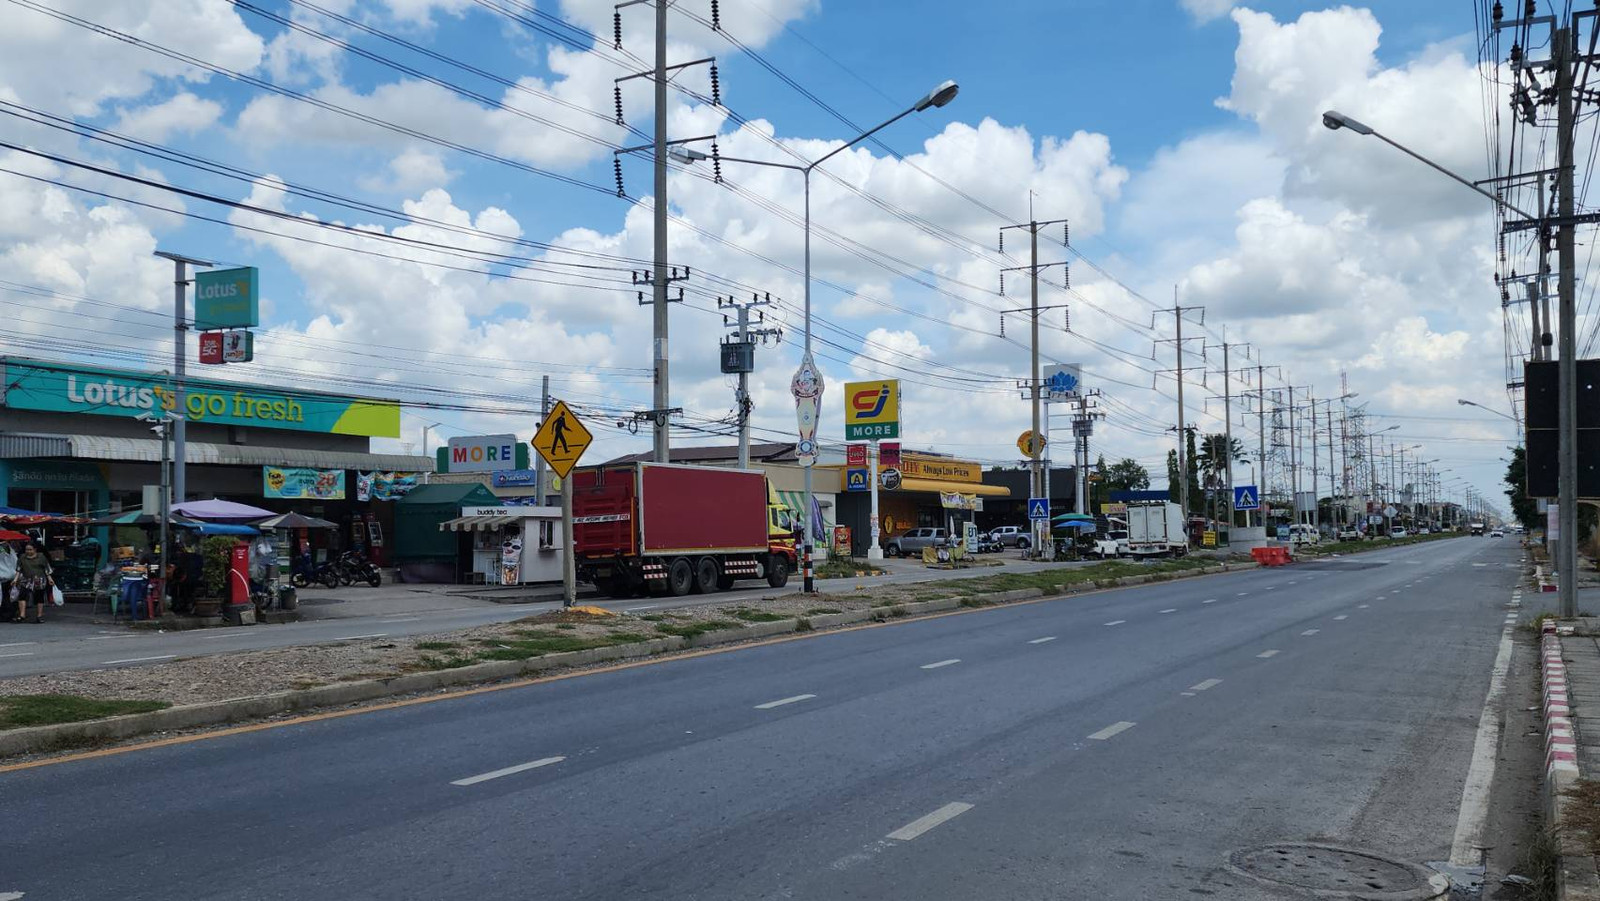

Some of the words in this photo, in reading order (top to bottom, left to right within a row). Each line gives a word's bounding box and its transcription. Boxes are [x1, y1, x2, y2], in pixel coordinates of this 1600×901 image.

[186, 393, 226, 420] go
[233, 392, 303, 421] fresh
[854, 425, 891, 436] MORE
[453, 446, 511, 463] MORE
[477, 509, 495, 517] buddy
